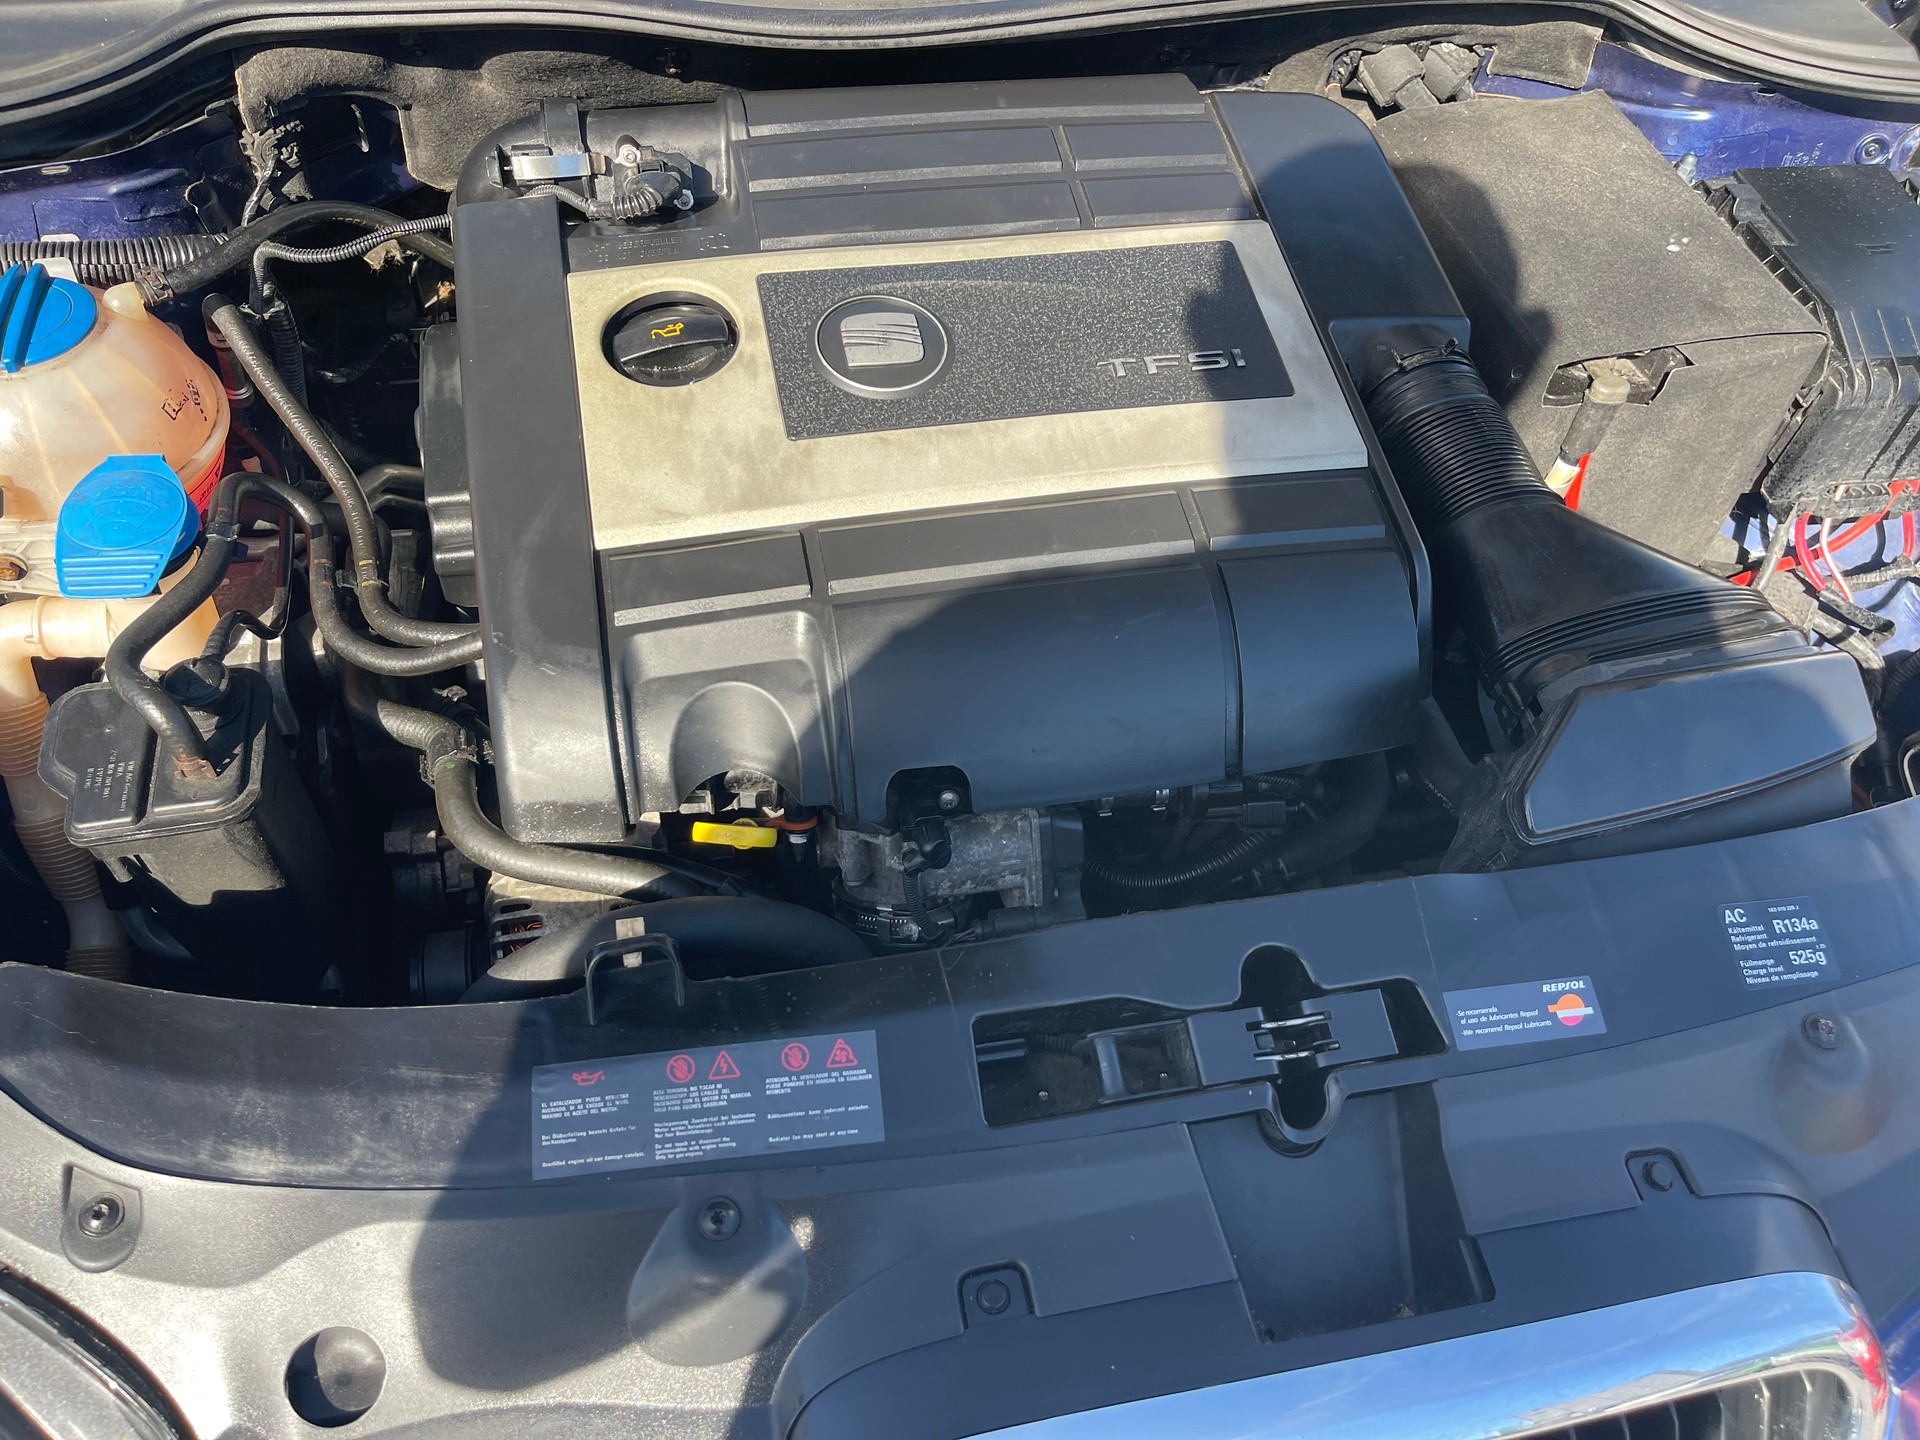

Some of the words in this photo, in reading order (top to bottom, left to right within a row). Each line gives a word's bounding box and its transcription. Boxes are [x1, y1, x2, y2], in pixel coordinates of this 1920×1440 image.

[1097, 349, 1246, 377] TFSI
[1724, 908, 1747, 924] AC
[1728, 924, 1764, 934] Kältemittel
[1772, 917, 1819, 934] R134a
[1731, 933, 1767, 943] Refrigerant
[1734, 943, 1757, 951] Moyen
[1768, 936, 1817, 947] refroidissement
[1740, 958, 1775, 968] Füllmenge
[1789, 949, 1827, 966] 525g
[1780, 970, 1819, 980] remplissage
[1542, 980, 1586, 993] REPSOL
[1489, 1012, 1519, 1021] lubricantes
[1520, 1009, 1539, 1019] Repsol
[1475, 1025, 1503, 1035] recomend
[1504, 1022, 1523, 1032] Repsol
[1524, 1020, 1552, 1029] Lubricants
[550, 1098, 582, 1107] CATALIZADOR
